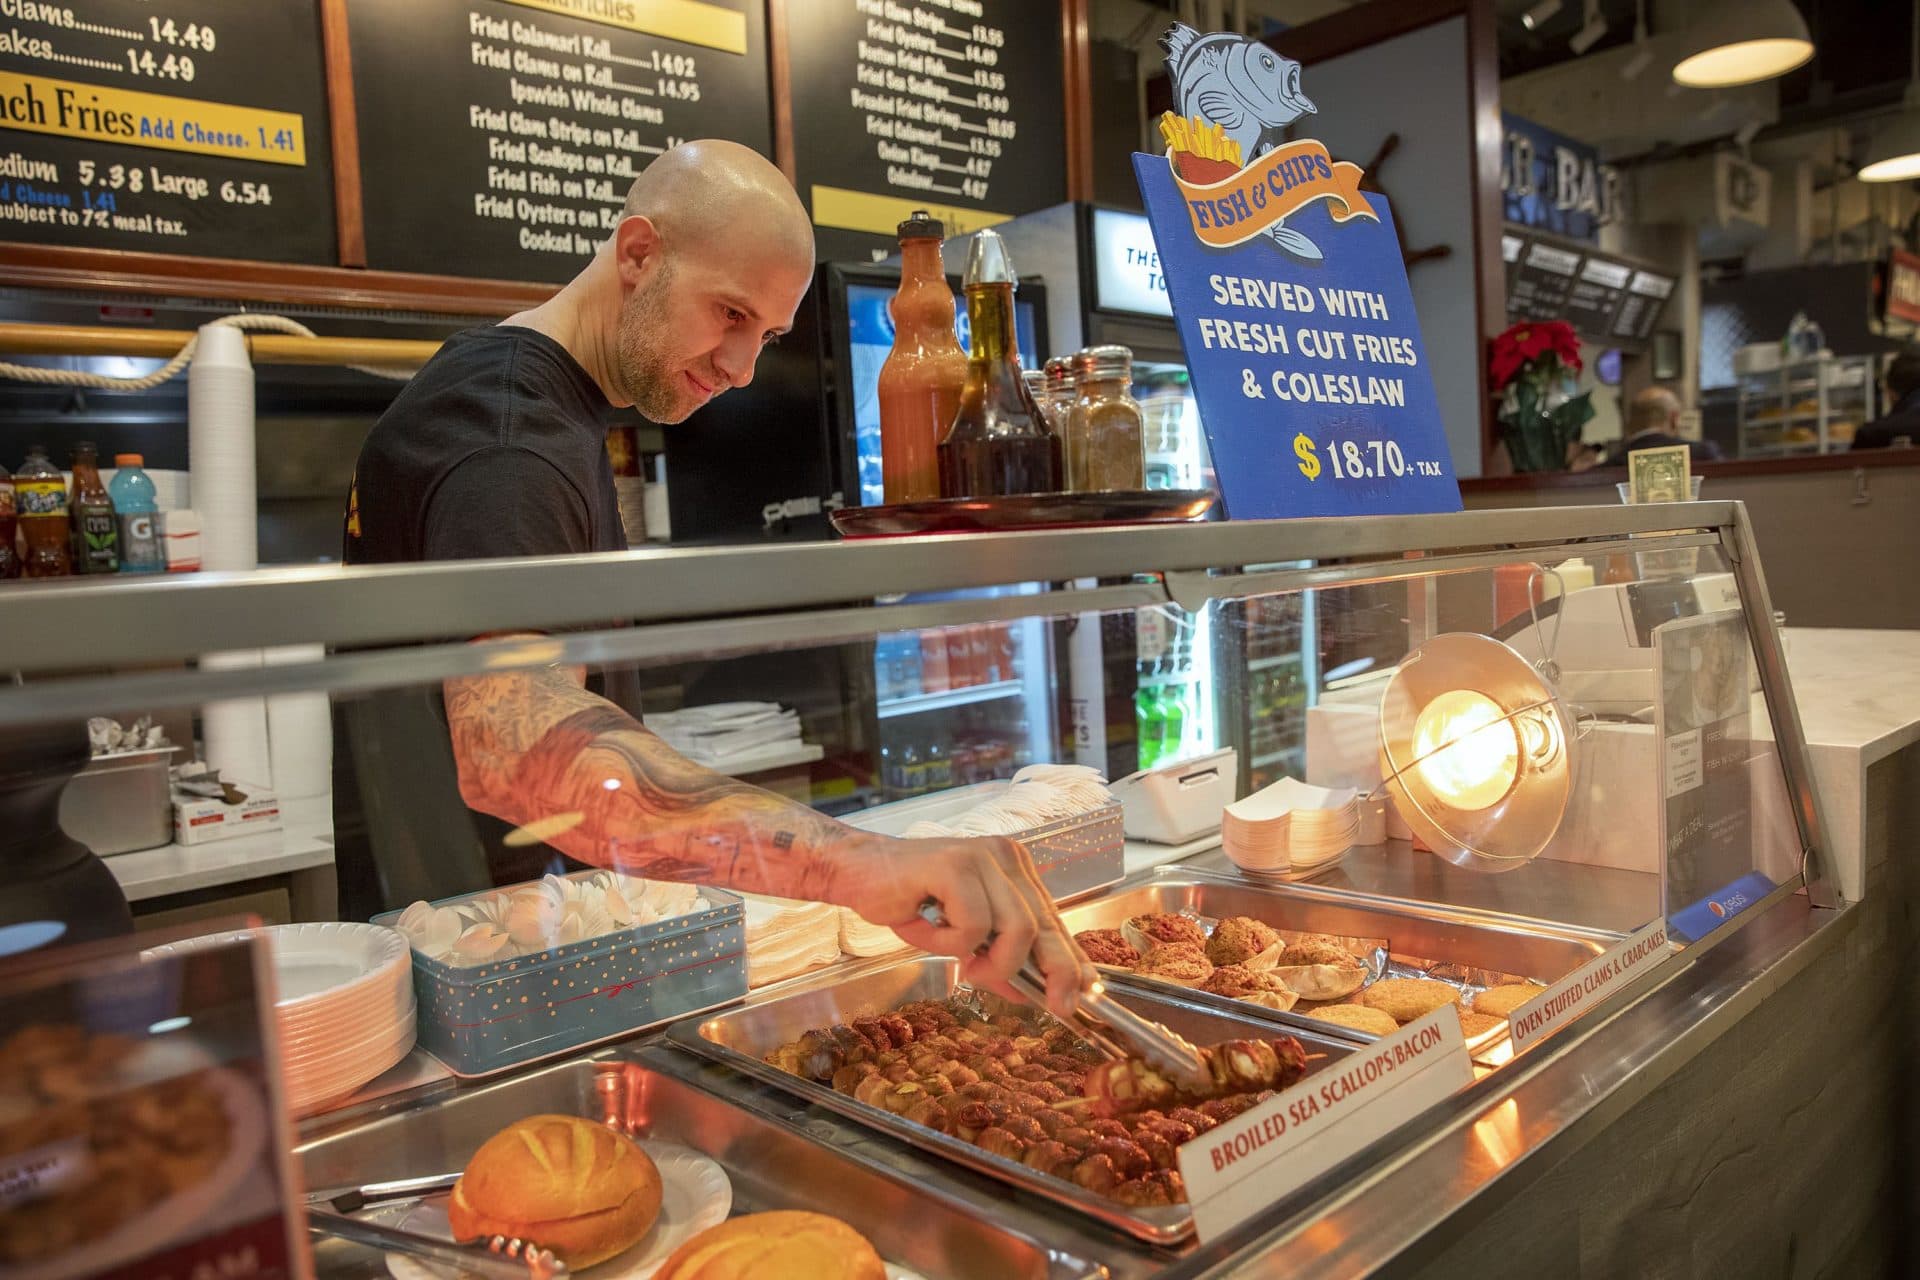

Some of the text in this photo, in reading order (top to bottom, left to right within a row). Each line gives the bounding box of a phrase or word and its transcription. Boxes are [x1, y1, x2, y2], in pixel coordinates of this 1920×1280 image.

[1, 0, 216, 51] Clams 14.49
[469, 12, 509, 41] Fried
[511, 20, 580, 55] Calamari
[127, 49, 195, 82] 14.49
[471, 42, 511, 70] Fried
[513, 50, 560, 79] Clams
[563, 65, 582, 83] on
[658, 77, 701, 102] 14.95
[55, 86, 135, 137] Fries
[140, 116, 174, 140] Add
[259, 127, 295, 152] 1.41
[510, 77, 664, 125] Ipswich Whole Clams
[469, 105, 507, 131] Fried
[509, 111, 547, 137] Clam
[549, 117, 592, 146] Strips
[593, 129, 612, 147] on
[489, 137, 527, 163] Fried
[528, 143, 584, 175] Scallops
[586, 154, 604, 173] on
[82, 189, 117, 212] 1.41
[151, 167, 209, 200] Large
[221, 181, 272, 206] 6.54
[488, 166, 527, 192] Fried
[529, 171, 561, 196] Fish
[563, 180, 583, 199] on
[1190, 153, 1333, 231] FISH & CHIPS
[60, 208, 79, 226] to
[82, 209, 110, 230] 7%
[113, 214, 151, 234] meal
[155, 216, 188, 237] tax.
[475, 193, 514, 219] Fried
[517, 198, 577, 225] Oysters
[578, 206, 598, 227] on
[519, 227, 572, 253] Cooked
[1208, 274, 1390, 321] SERVED WITH
[1199, 318, 1418, 366] FRESH CUT FRIES
[1241, 369, 1406, 408] & COLESLAW
[1293, 432, 1321, 482] $
[1326, 439, 1405, 478] 18.70
[1416, 461, 1443, 476] TAX
[130, 517, 152, 540] G
[1515, 929, 1666, 1041] OVEN STUFFED CLAMS & CRABCAKES
[1210, 1023, 1443, 1173] BROILED SEA SCALLOPS/BACON
